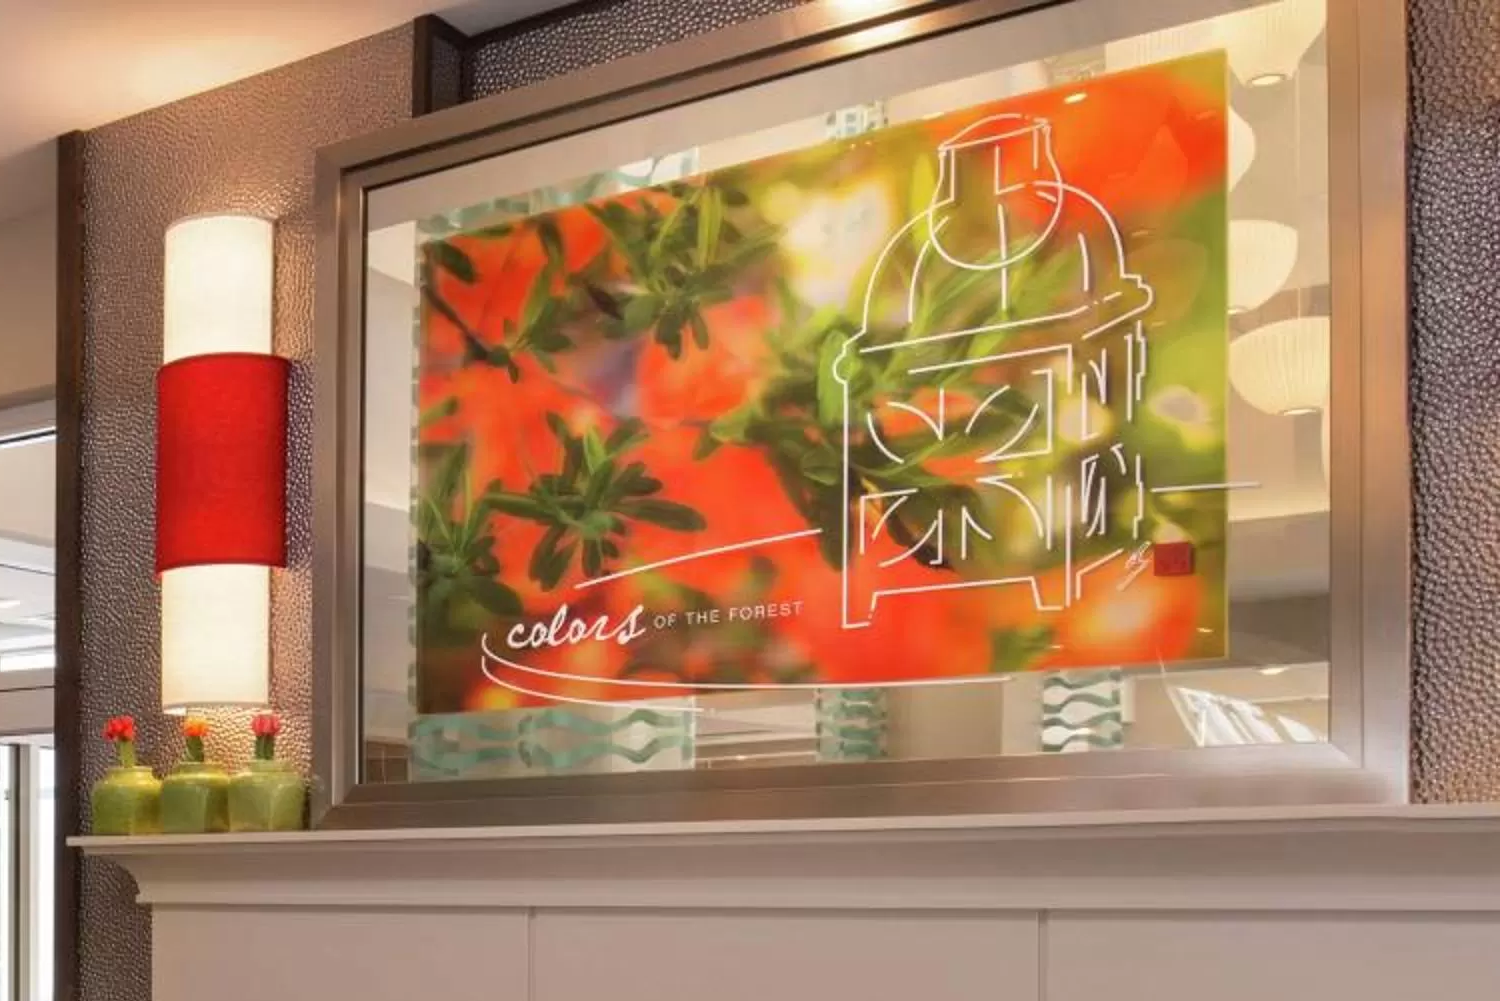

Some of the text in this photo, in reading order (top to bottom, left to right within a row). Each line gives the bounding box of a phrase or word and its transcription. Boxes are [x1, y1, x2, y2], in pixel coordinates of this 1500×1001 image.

[507, 600, 804, 649] colors OF THE FOREST
